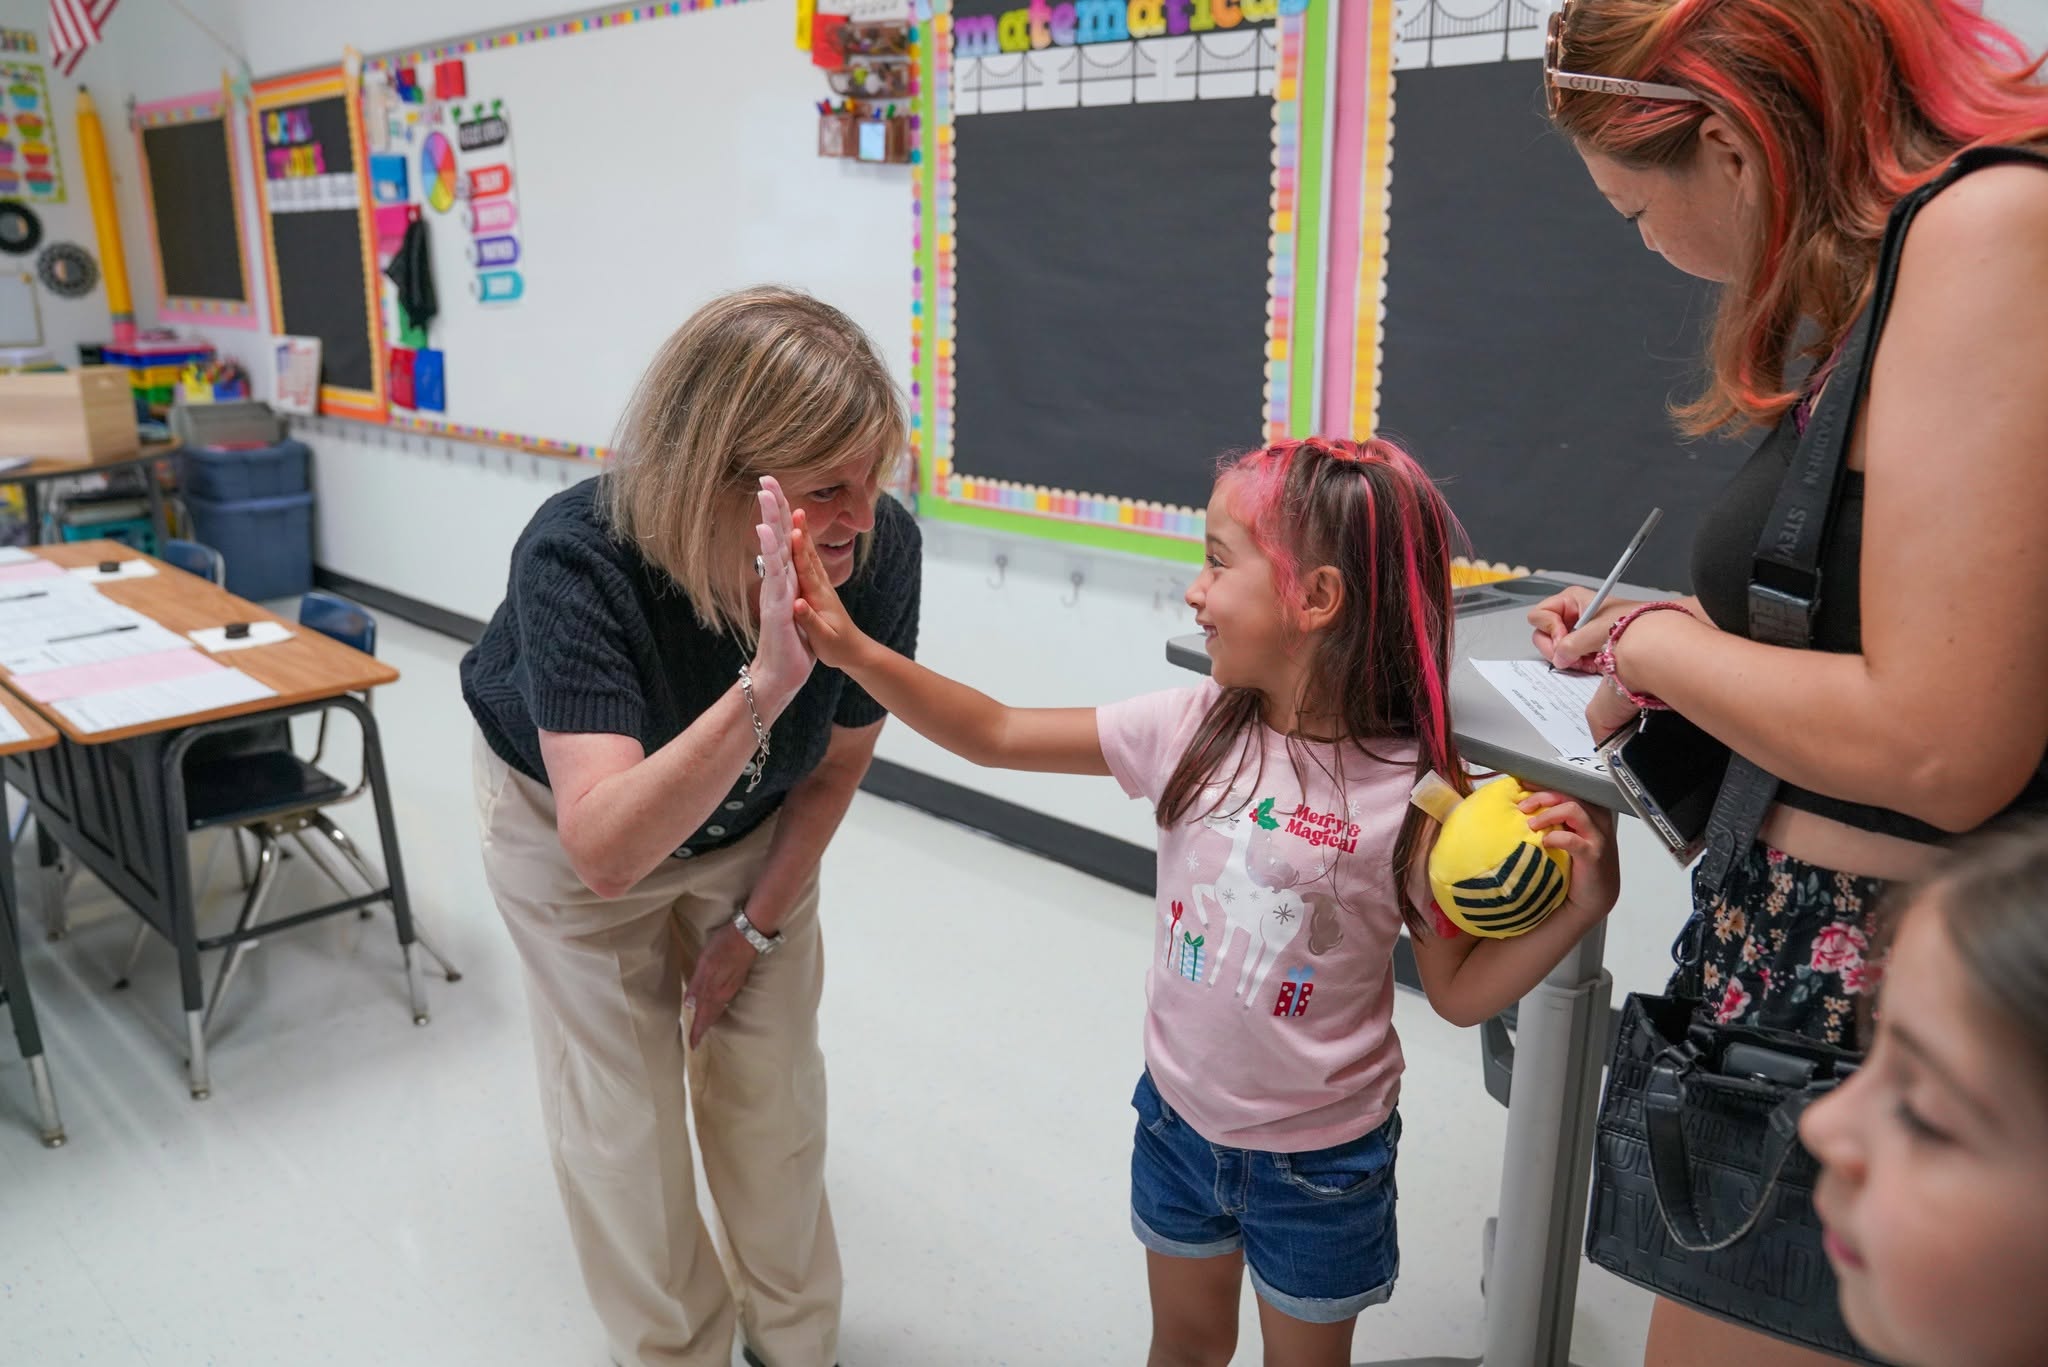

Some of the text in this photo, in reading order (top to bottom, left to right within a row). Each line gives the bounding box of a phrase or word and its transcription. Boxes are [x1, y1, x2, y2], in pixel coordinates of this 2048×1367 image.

[1568, 76, 1640, 96] GUESS
[1284, 818, 1358, 855] Magical
[1292, 804, 1361, 837] Merry &
